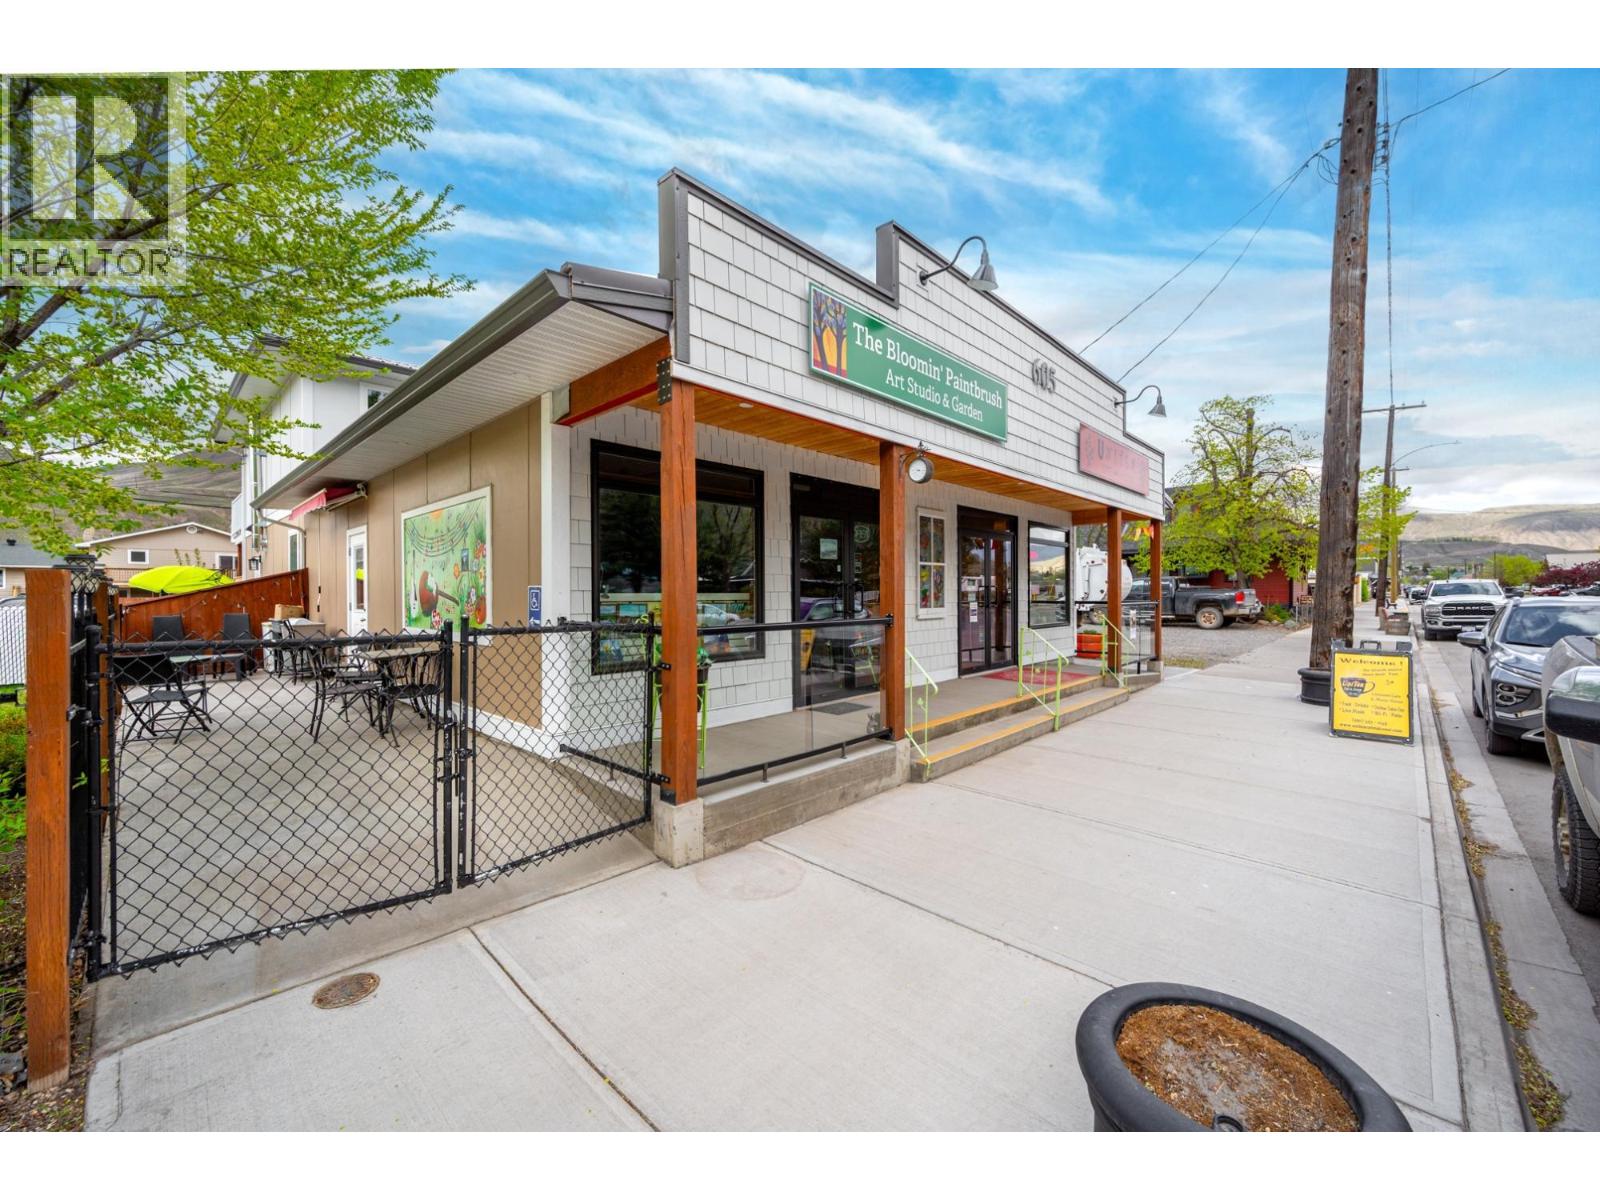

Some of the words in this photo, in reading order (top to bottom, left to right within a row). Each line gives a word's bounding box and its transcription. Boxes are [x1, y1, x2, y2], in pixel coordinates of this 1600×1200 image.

[852, 322, 883, 355] The
[886, 338, 944, 381] Bloomin'
[945, 367, 1003, 409] Paintbrush
[1031, 358, 1056, 394] 605
[885, 368, 905, 391] Art
[907, 378, 941, 405] Studio
[943, 393, 950, 408] &
[951, 395, 984, 422] Garden
